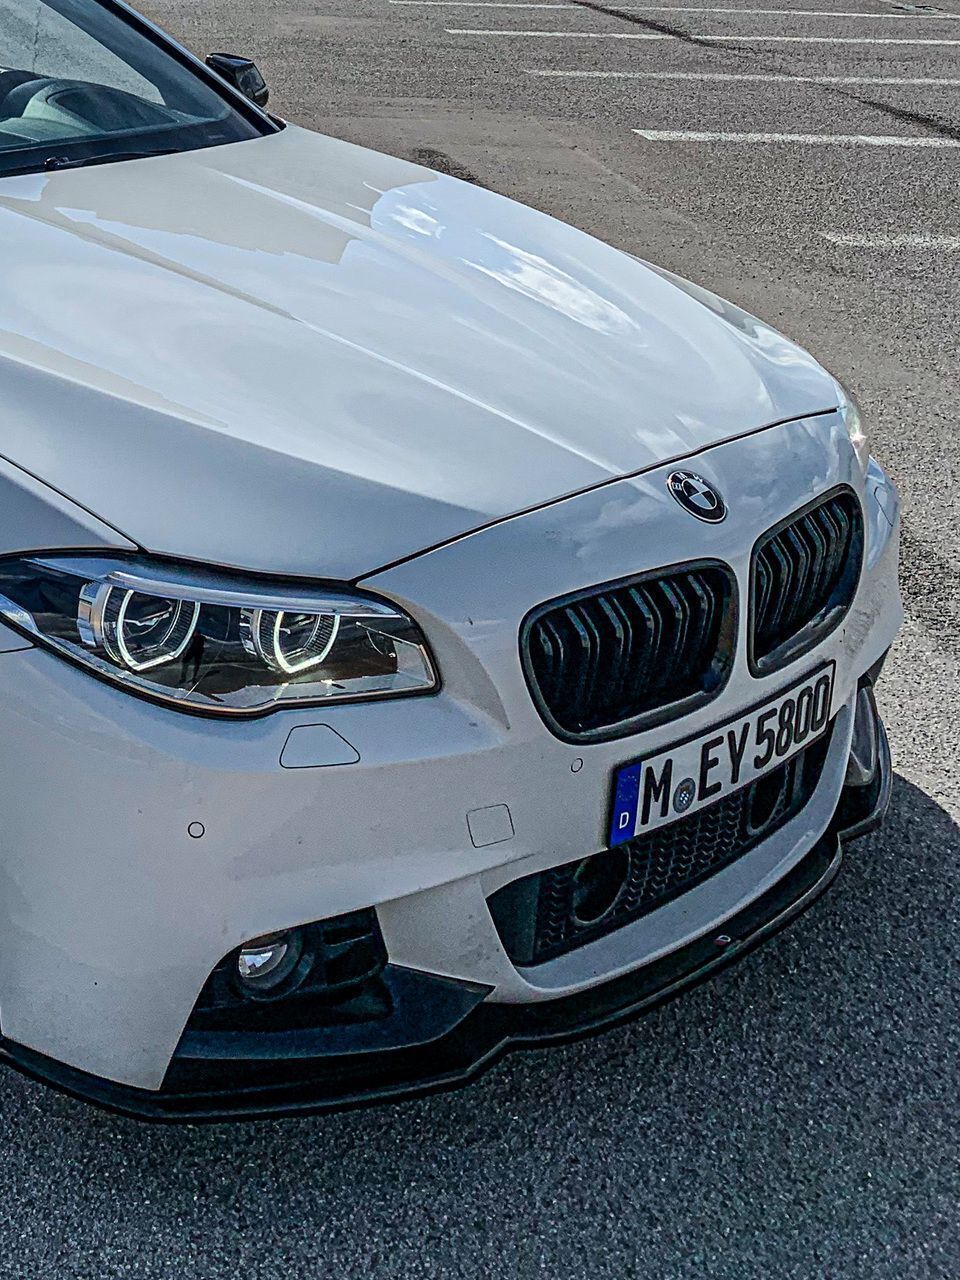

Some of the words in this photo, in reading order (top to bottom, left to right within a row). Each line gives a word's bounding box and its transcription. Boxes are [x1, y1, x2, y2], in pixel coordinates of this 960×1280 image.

[641, 759, 673, 825] M
[698, 722, 750, 801] EY
[754, 675, 830, 769] 5800
[619, 812, 629, 829] D
